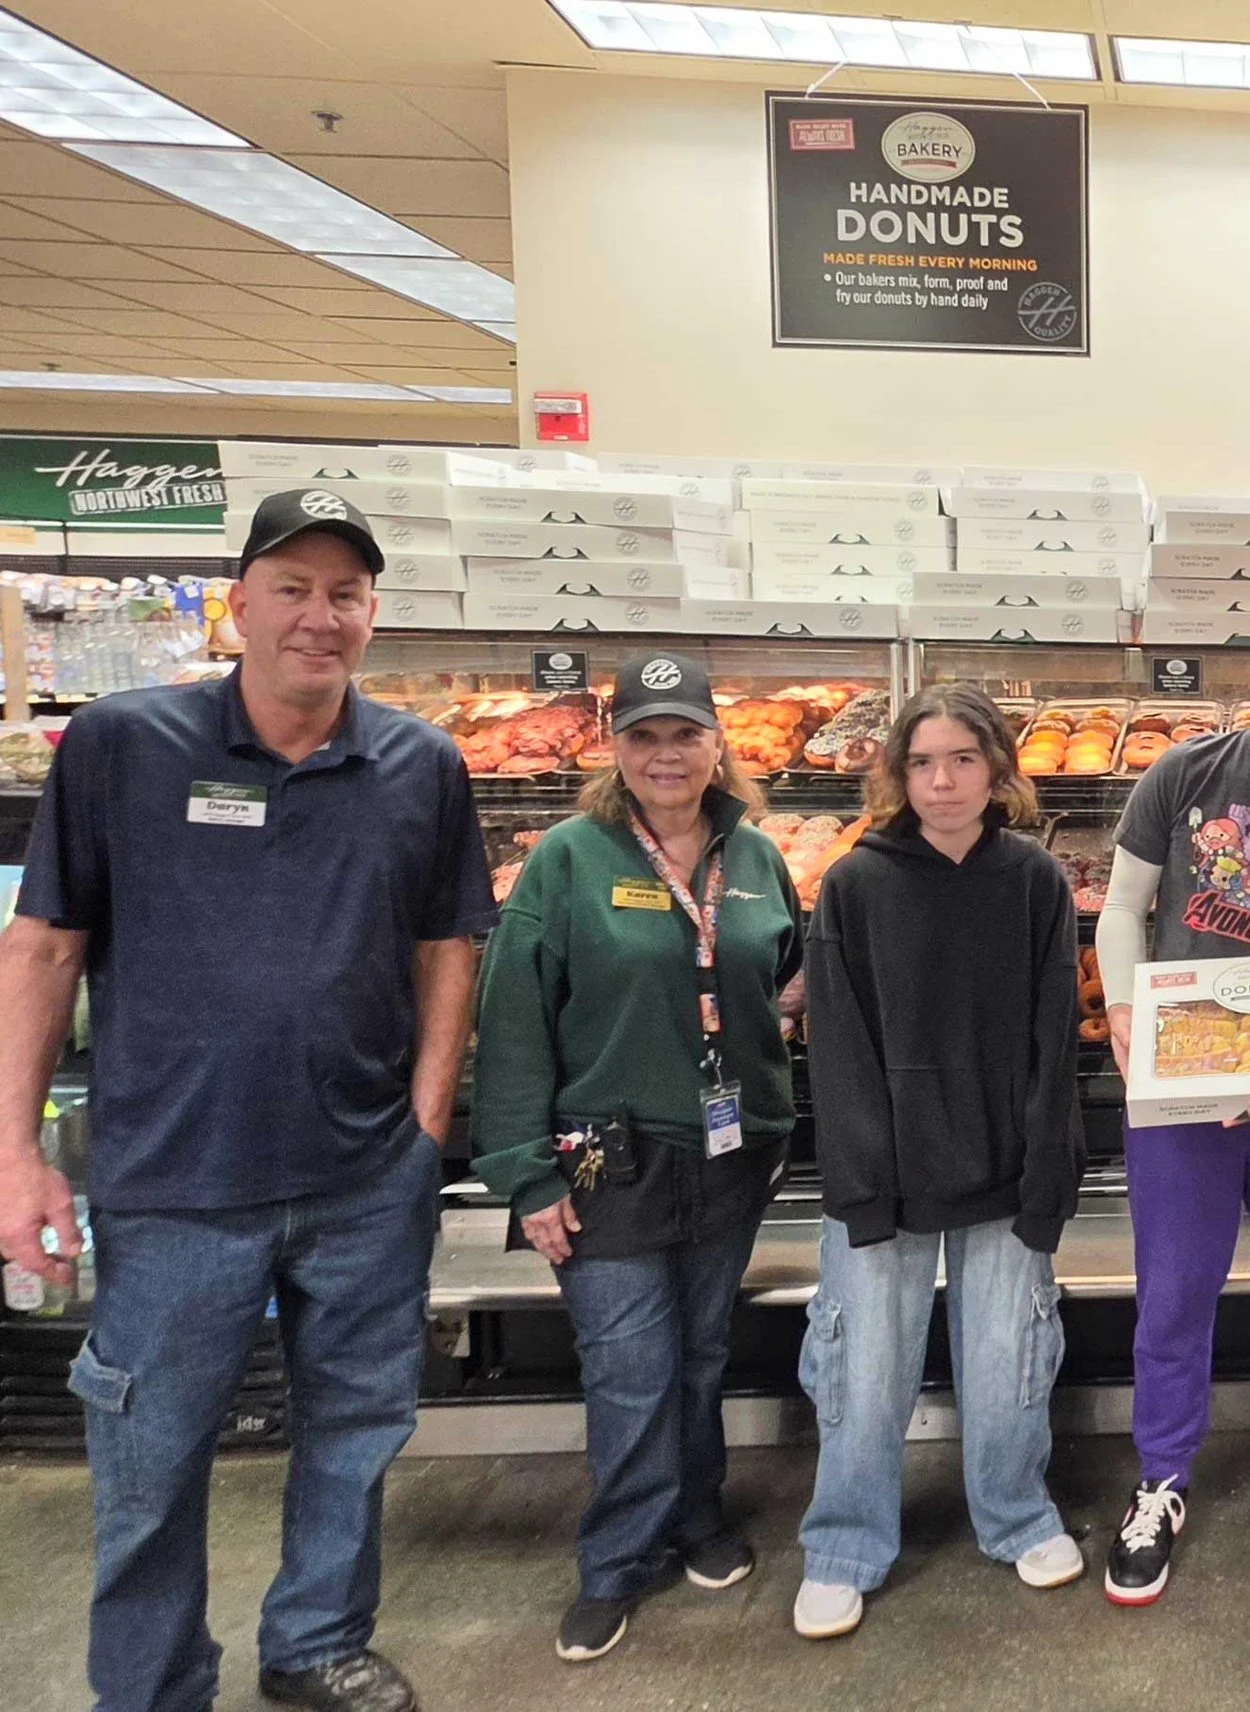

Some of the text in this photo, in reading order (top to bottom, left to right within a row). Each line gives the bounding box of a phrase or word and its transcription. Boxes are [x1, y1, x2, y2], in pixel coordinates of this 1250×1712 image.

[897, 143, 962, 158] BAKERY
[849, 181, 1009, 208] HANDMADE
[836, 208, 1024, 248] DONUTS
[823, 253, 1038, 271] MADE FRESH EVERY MORNING
[835, 272, 1008, 291] Our bakers mix, form, proof and
[836, 290, 988, 310] fry our donuts by hand daily
[1034, 314, 1071, 337] QUALITY
[34, 449, 223, 489] Haggen
[73, 482, 223, 514] NORTHWEST FRESH
[207, 801, 249, 814] Daryn
[627, 890, 658, 899] Karen
